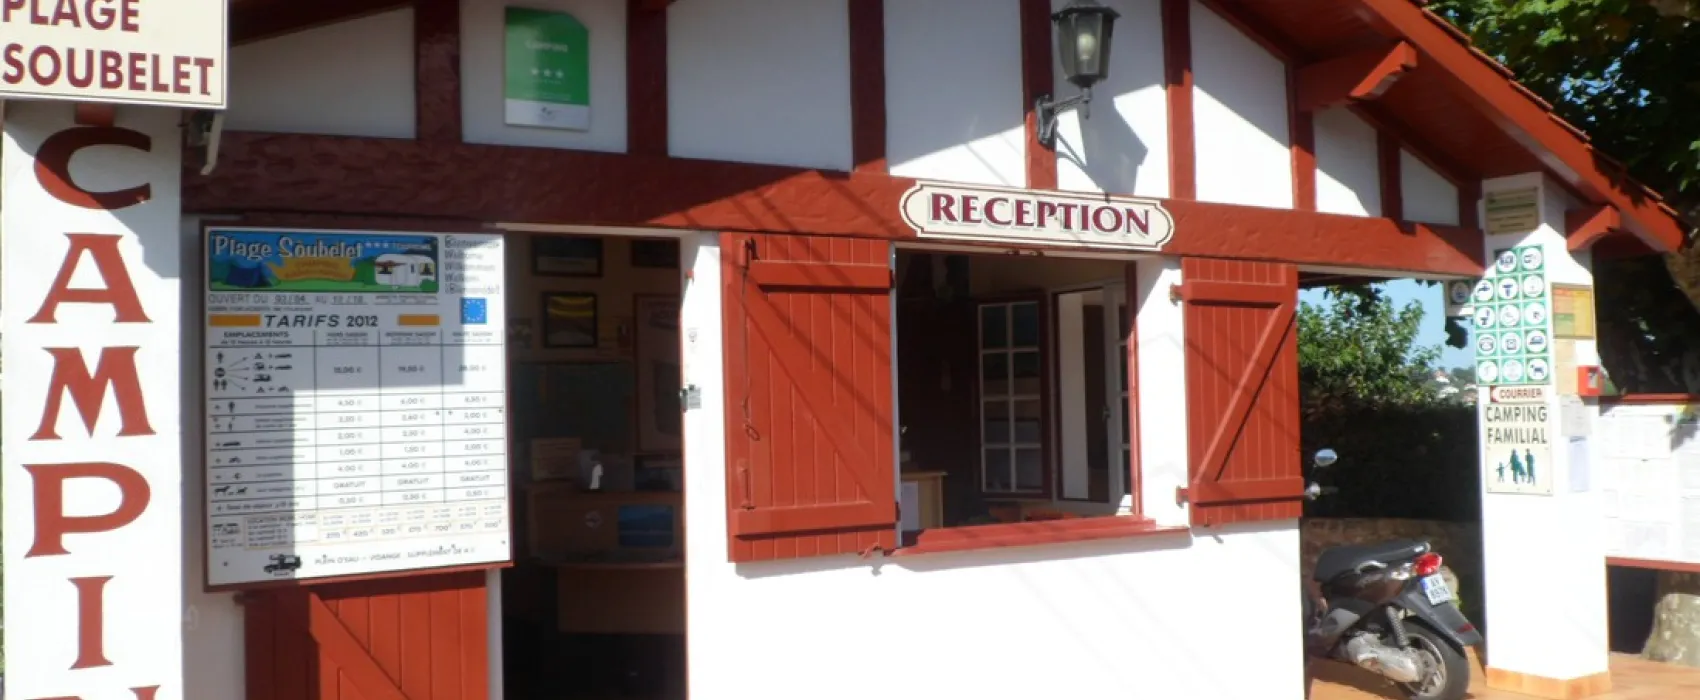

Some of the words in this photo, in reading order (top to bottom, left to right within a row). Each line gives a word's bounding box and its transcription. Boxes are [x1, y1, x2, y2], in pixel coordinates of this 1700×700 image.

[2, 0, 141, 33] PLAGE
[2, 43, 214, 96] SOUBELET
[929, 192, 1150, 236] RECEPTION
[213, 235, 273, 262] Plage
[264, 314, 340, 328] TARIFS
[345, 315, 379, 328] 2012
[1500, 387, 1543, 400] COURRIER
[22, 125, 160, 700] CAMPI
[1486, 405, 1549, 422] CAMPING
[1487, 426, 1548, 445] FAMILIAL
